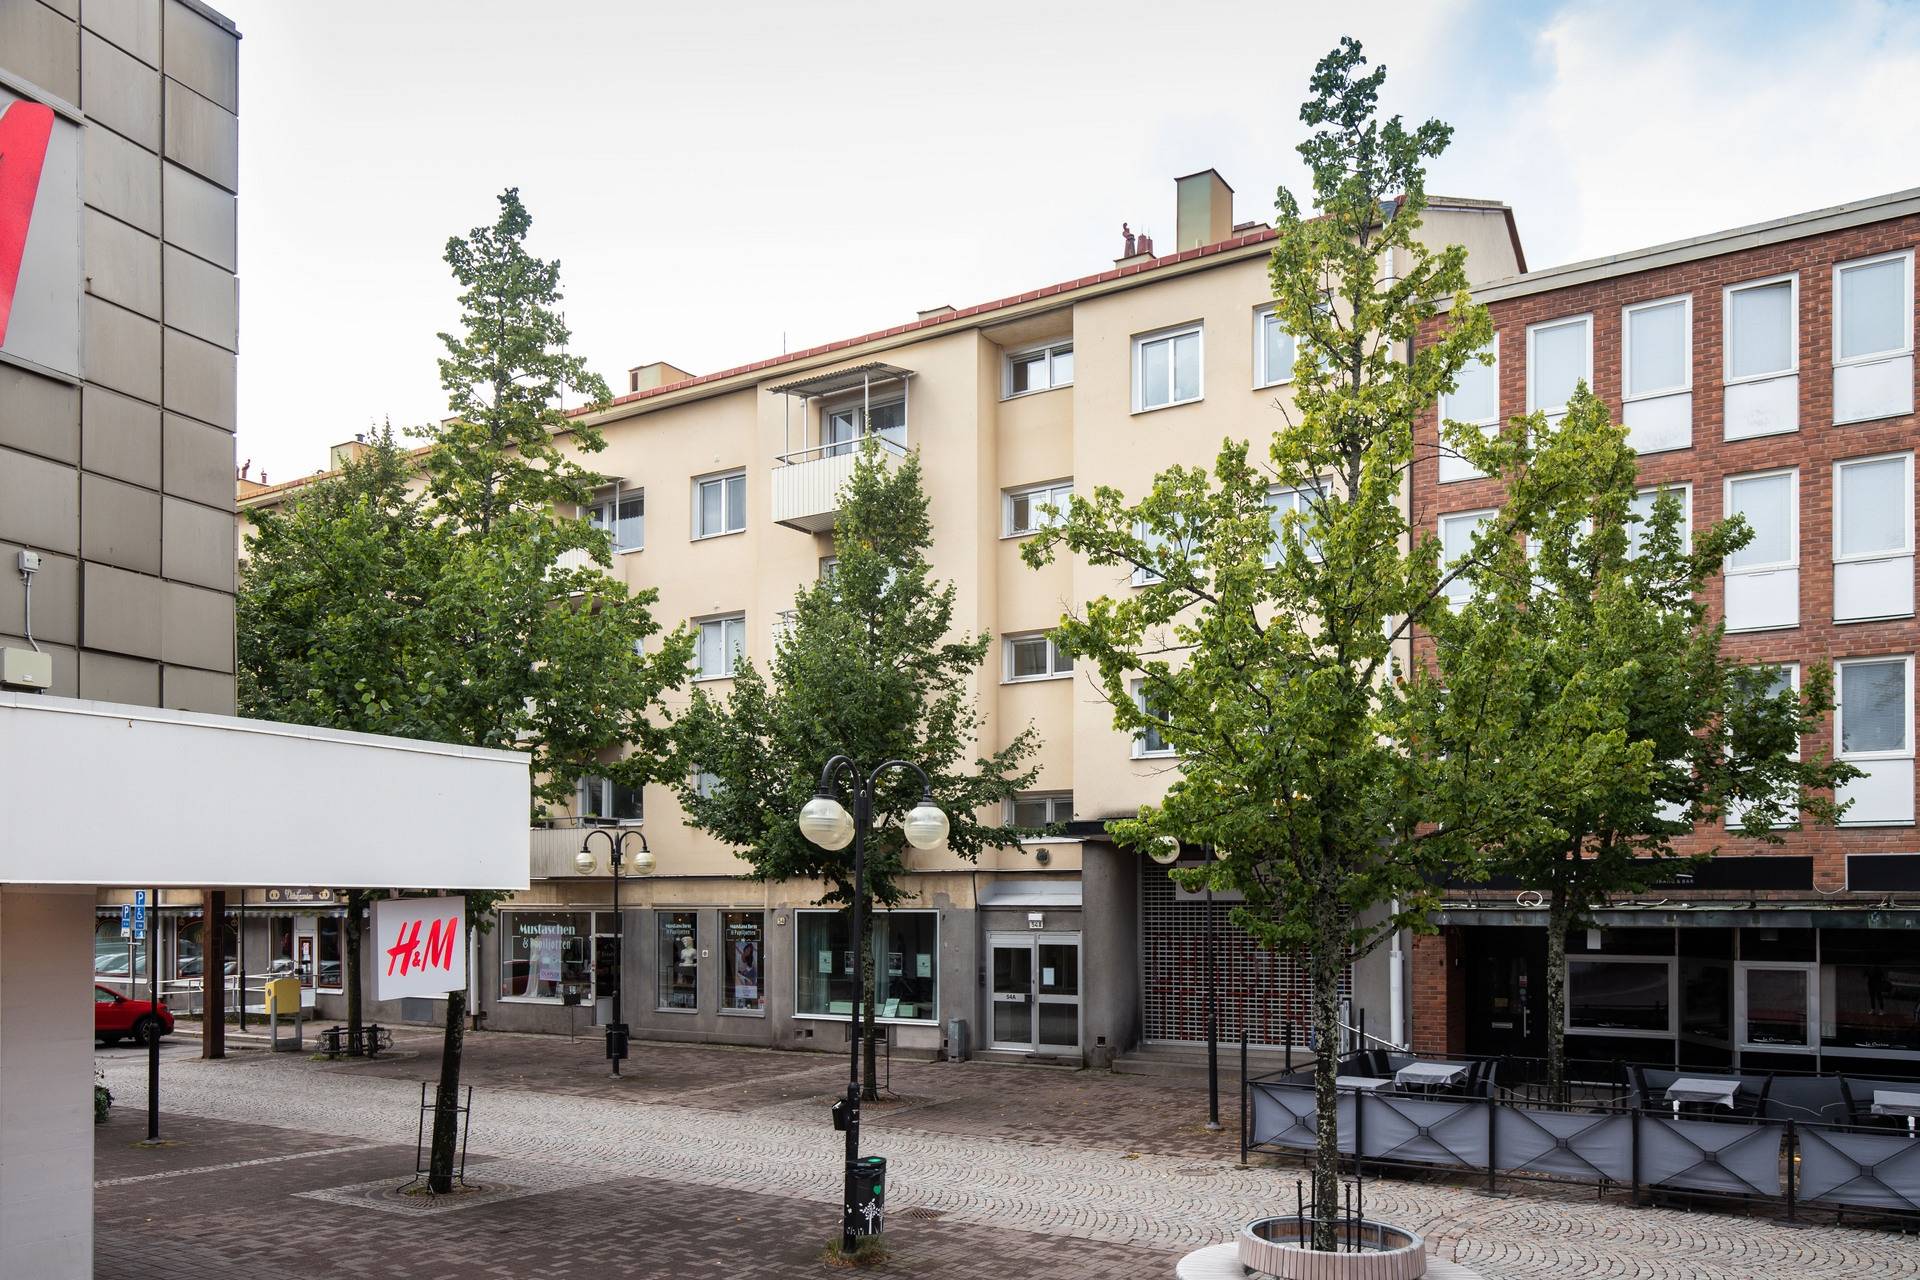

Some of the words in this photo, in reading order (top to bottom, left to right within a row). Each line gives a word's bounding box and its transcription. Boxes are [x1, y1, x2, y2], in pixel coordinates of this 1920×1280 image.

[138, 892, 144, 904] P
[124, 906, 129, 918] P
[519, 924, 576, 935] Mustaschen
[387, 917, 458, 977] H&M
[522, 937, 529, 949] &
